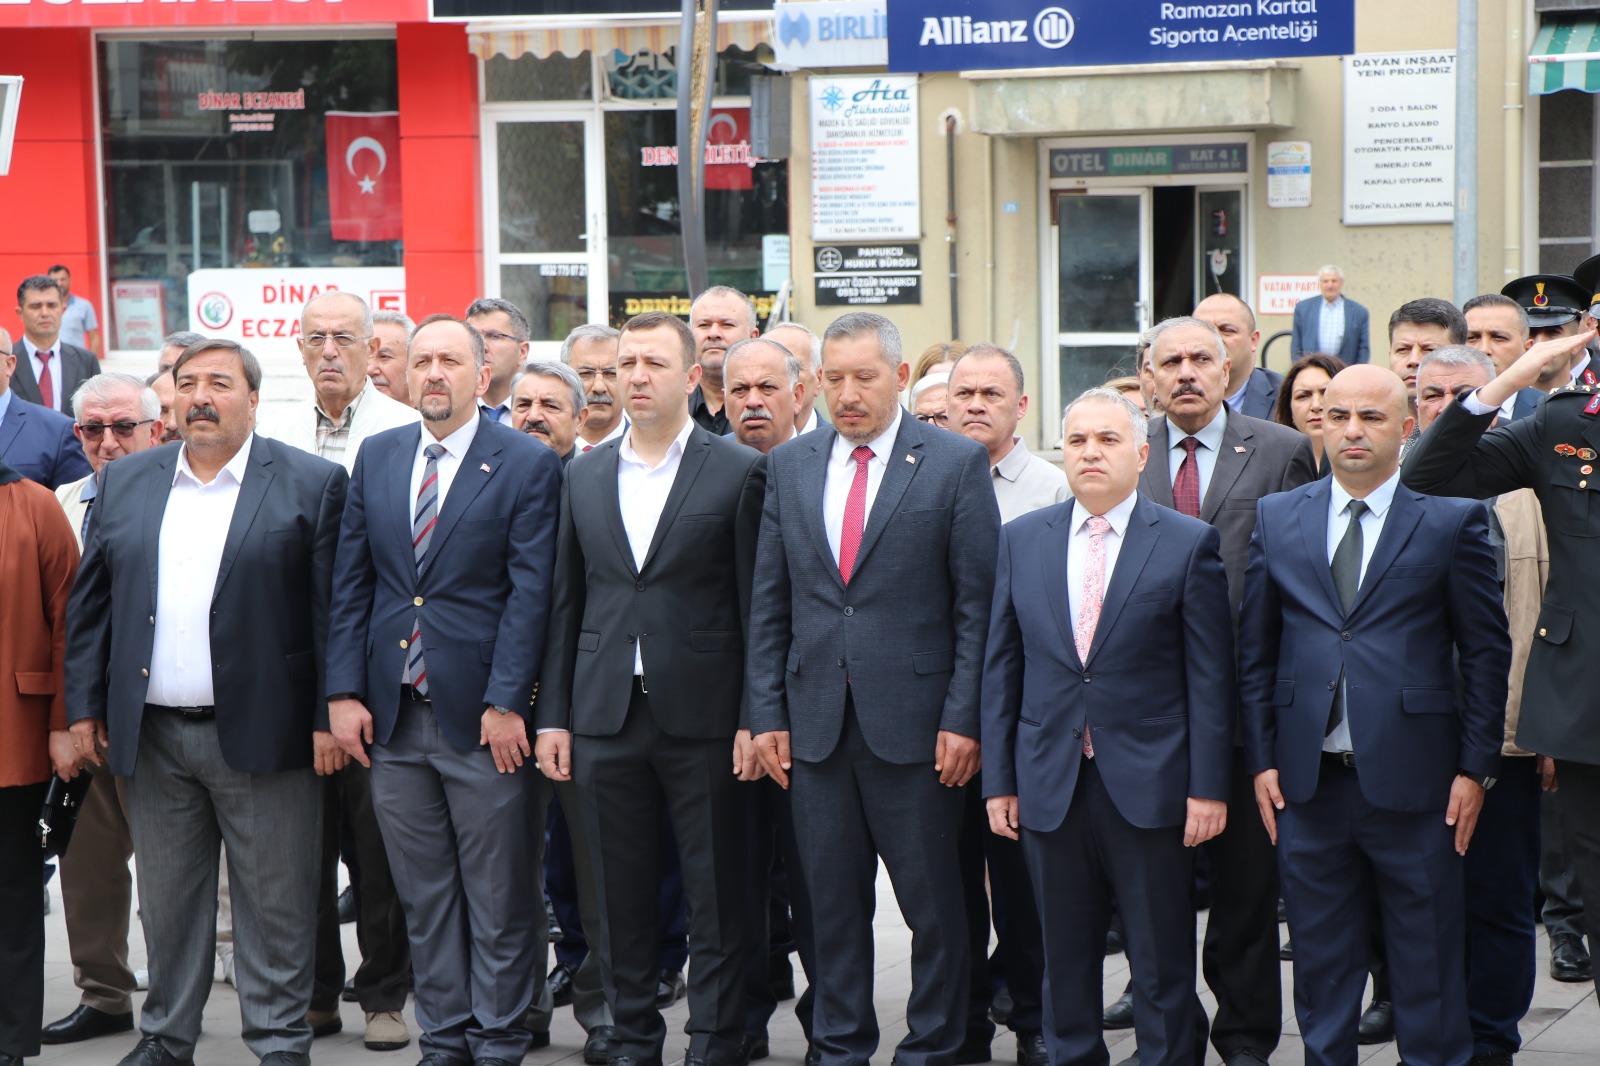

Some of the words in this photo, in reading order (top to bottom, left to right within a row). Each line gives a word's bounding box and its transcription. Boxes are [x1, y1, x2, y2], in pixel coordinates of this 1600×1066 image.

[1161, 3, 1252, 20] Ramazan
[1257, 0, 1318, 17] Kartal
[818, 9, 888, 41] BİRLİ
[919, 16, 1028, 46] Allianz
[1149, 27, 1219, 48] Sigorta
[1222, 20, 1318, 43] Acenteliği
[1353, 58, 1400, 68] DAYAN
[199, 89, 242, 110] DİNAR
[243, 87, 305, 110] ECZANESİ
[852, 79, 911, 103] Ata
[844, 103, 912, 118] Mühendislik
[1402, 120, 1439, 128] LAVABO
[641, 146, 678, 167] DEN
[1054, 153, 1104, 172] OTEL
[1190, 150, 1215, 162] KAT
[1218, 149, 1228, 160] 4
[844, 259, 877, 268] HUKUK
[878, 257, 917, 268] BÜROSU
[818, 278, 852, 288] AVUKAT
[851, 276, 878, 287] ÖZGÜR
[1264, 281, 1292, 292] VATAN
[242, 319, 301, 337] ECZA
